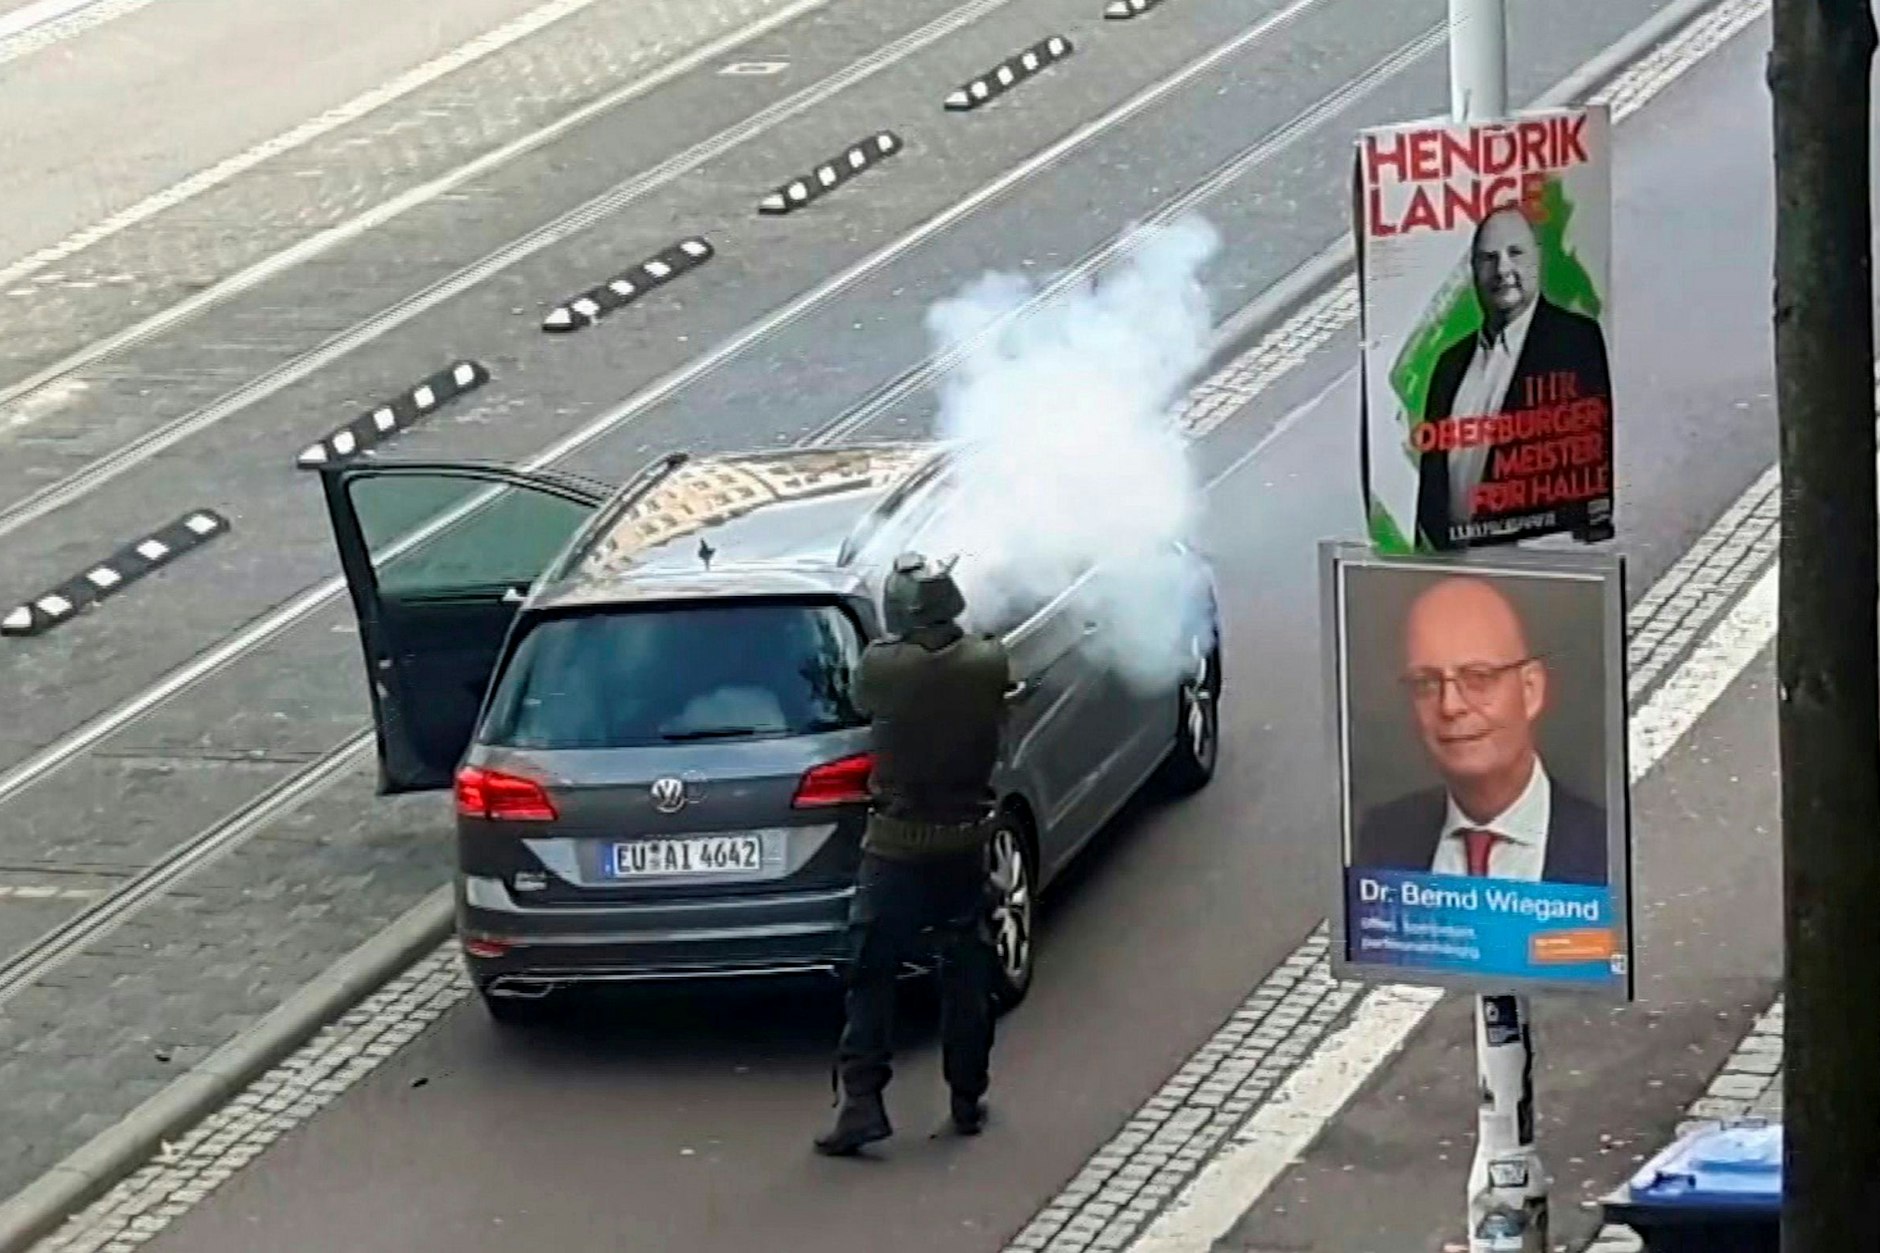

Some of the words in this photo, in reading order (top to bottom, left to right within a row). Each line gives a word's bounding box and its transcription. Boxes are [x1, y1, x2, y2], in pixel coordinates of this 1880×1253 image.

[1367, 115, 1588, 183] HENDRIK
[1370, 173, 1549, 236] LANGE
[1494, 431, 1603, 480] MEISTER
[1531, 463, 1609, 505] HALLE
[699, 840, 757, 868] 4642
[1360, 878, 1393, 902] Dr.
[1402, 881, 1478, 910] Bernd
[1485, 888, 1600, 921] Wiegand
